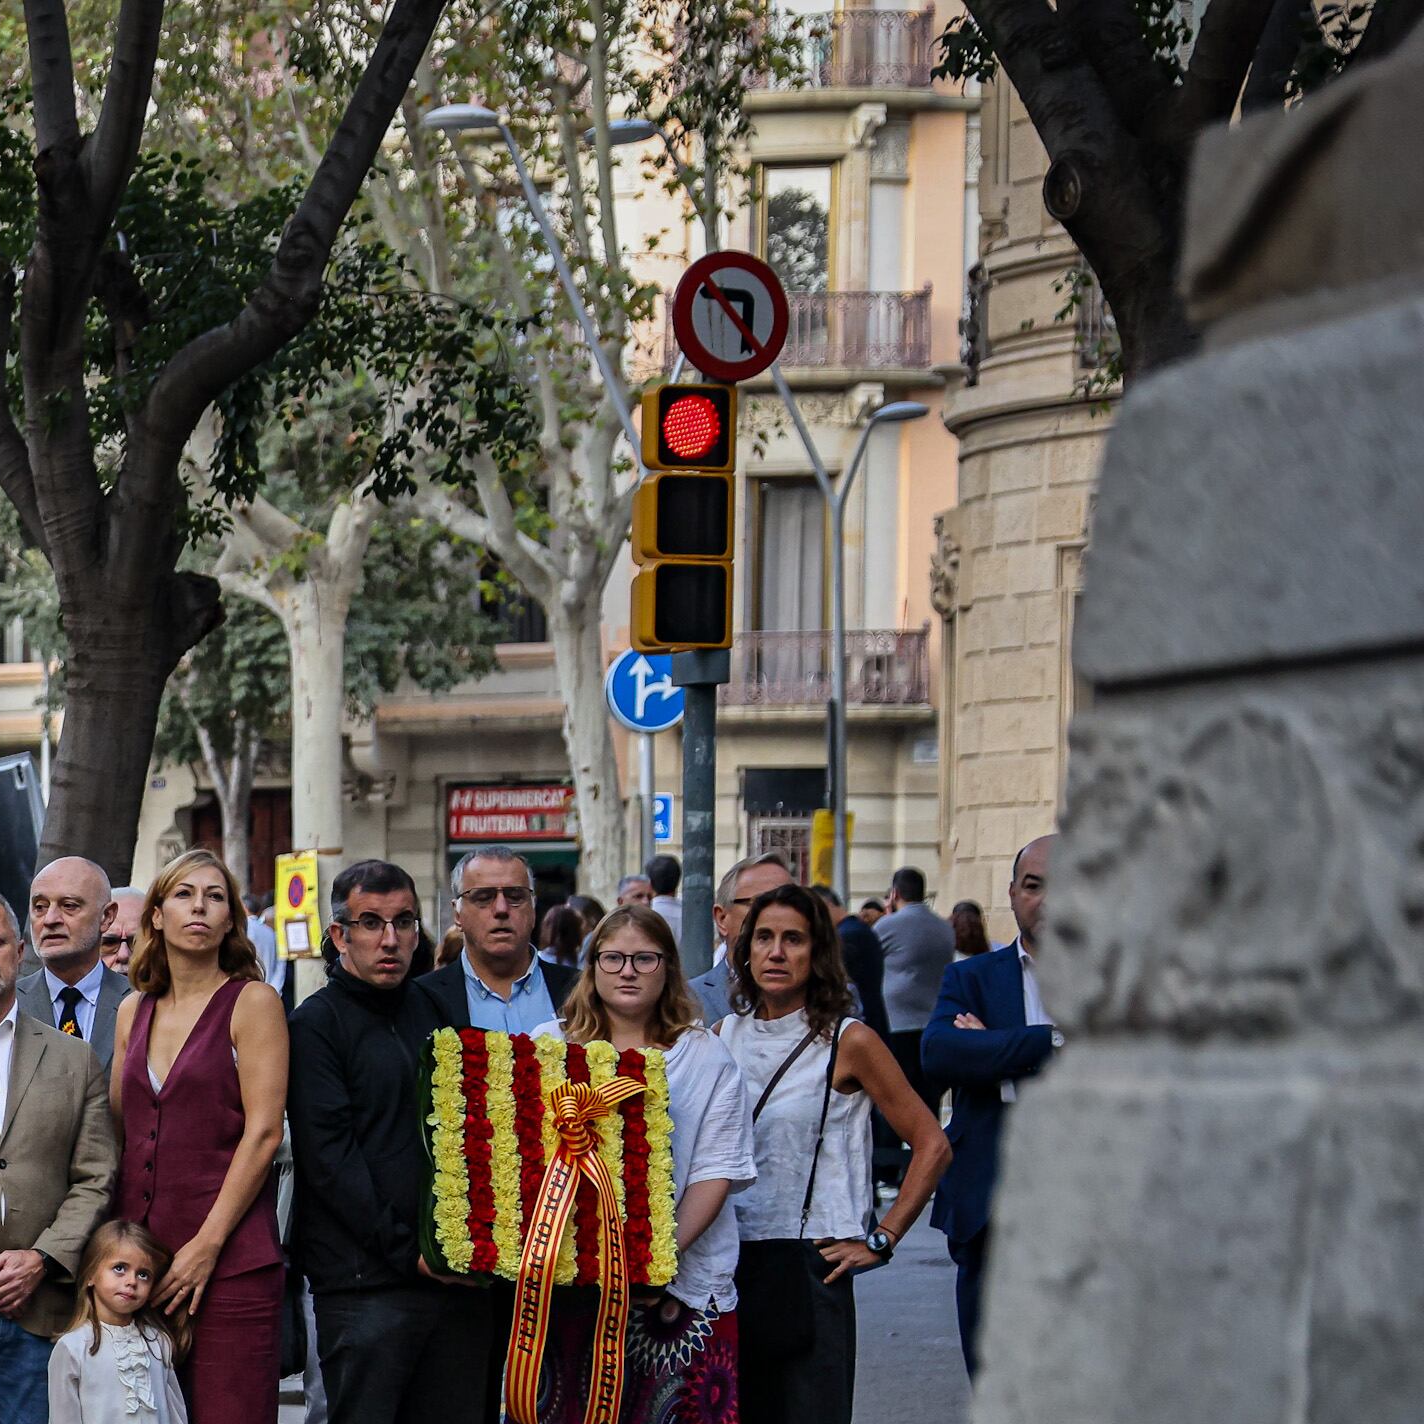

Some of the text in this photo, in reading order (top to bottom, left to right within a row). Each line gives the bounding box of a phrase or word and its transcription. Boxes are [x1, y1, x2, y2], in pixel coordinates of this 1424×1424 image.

[475, 789, 566, 809] SUPERMERCAT
[462, 815, 526, 833] FRUITERIA
[607, 1216, 624, 1311] SPECIAL
